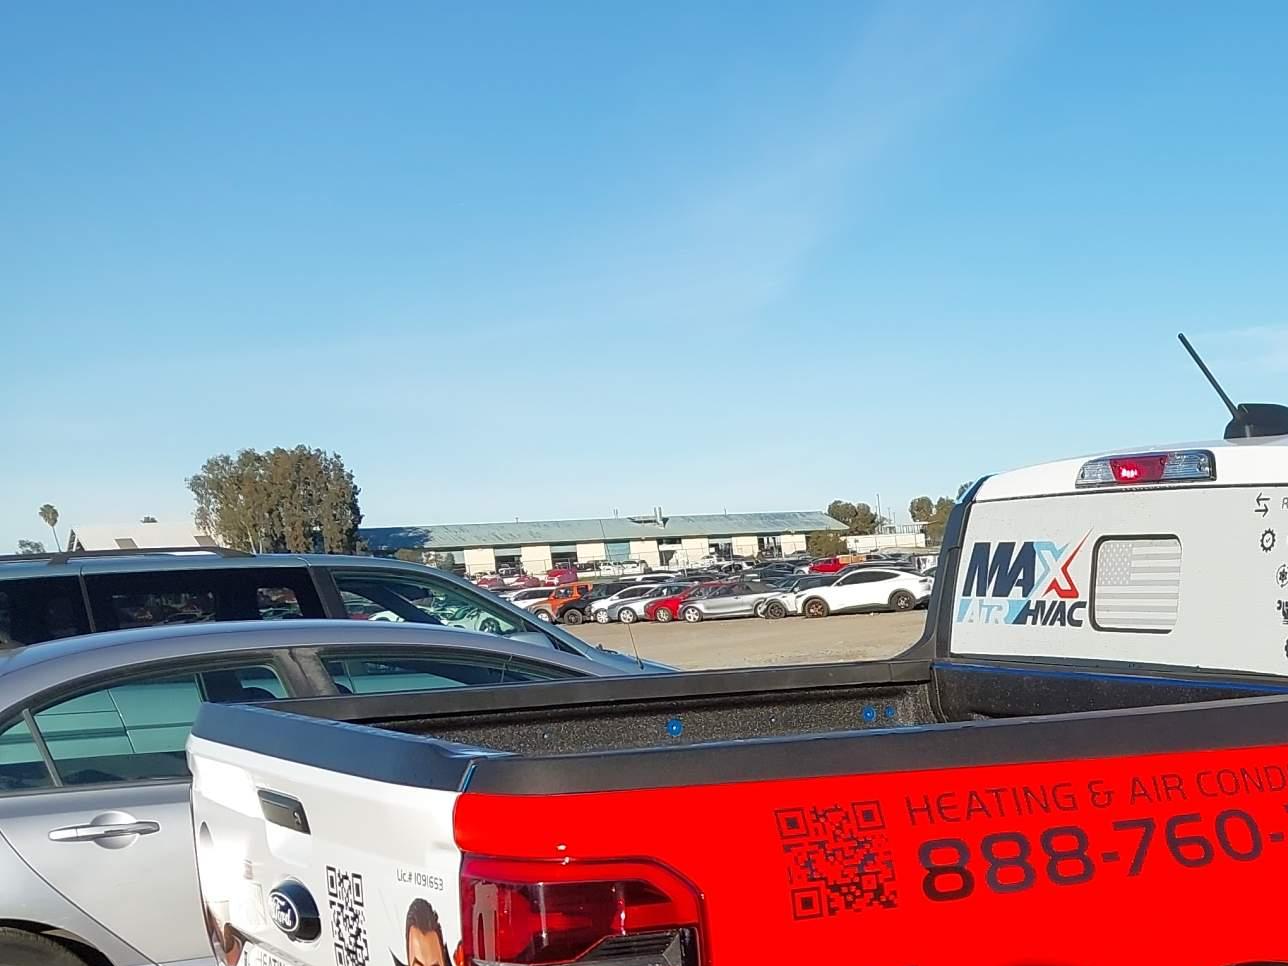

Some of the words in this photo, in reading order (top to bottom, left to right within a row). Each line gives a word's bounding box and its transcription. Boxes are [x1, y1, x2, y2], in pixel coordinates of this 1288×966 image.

[962, 528, 1093, 598] MAX
[1012, 600, 1087, 627] HVAC
[905, 781, 1076, 826] HEATING
[1088, 779, 1114, 809] &
[1129, 773, 1188, 805] AIR
[414, 871, 444, 891] 1091653
[271, 895, 291, 927] Ford
